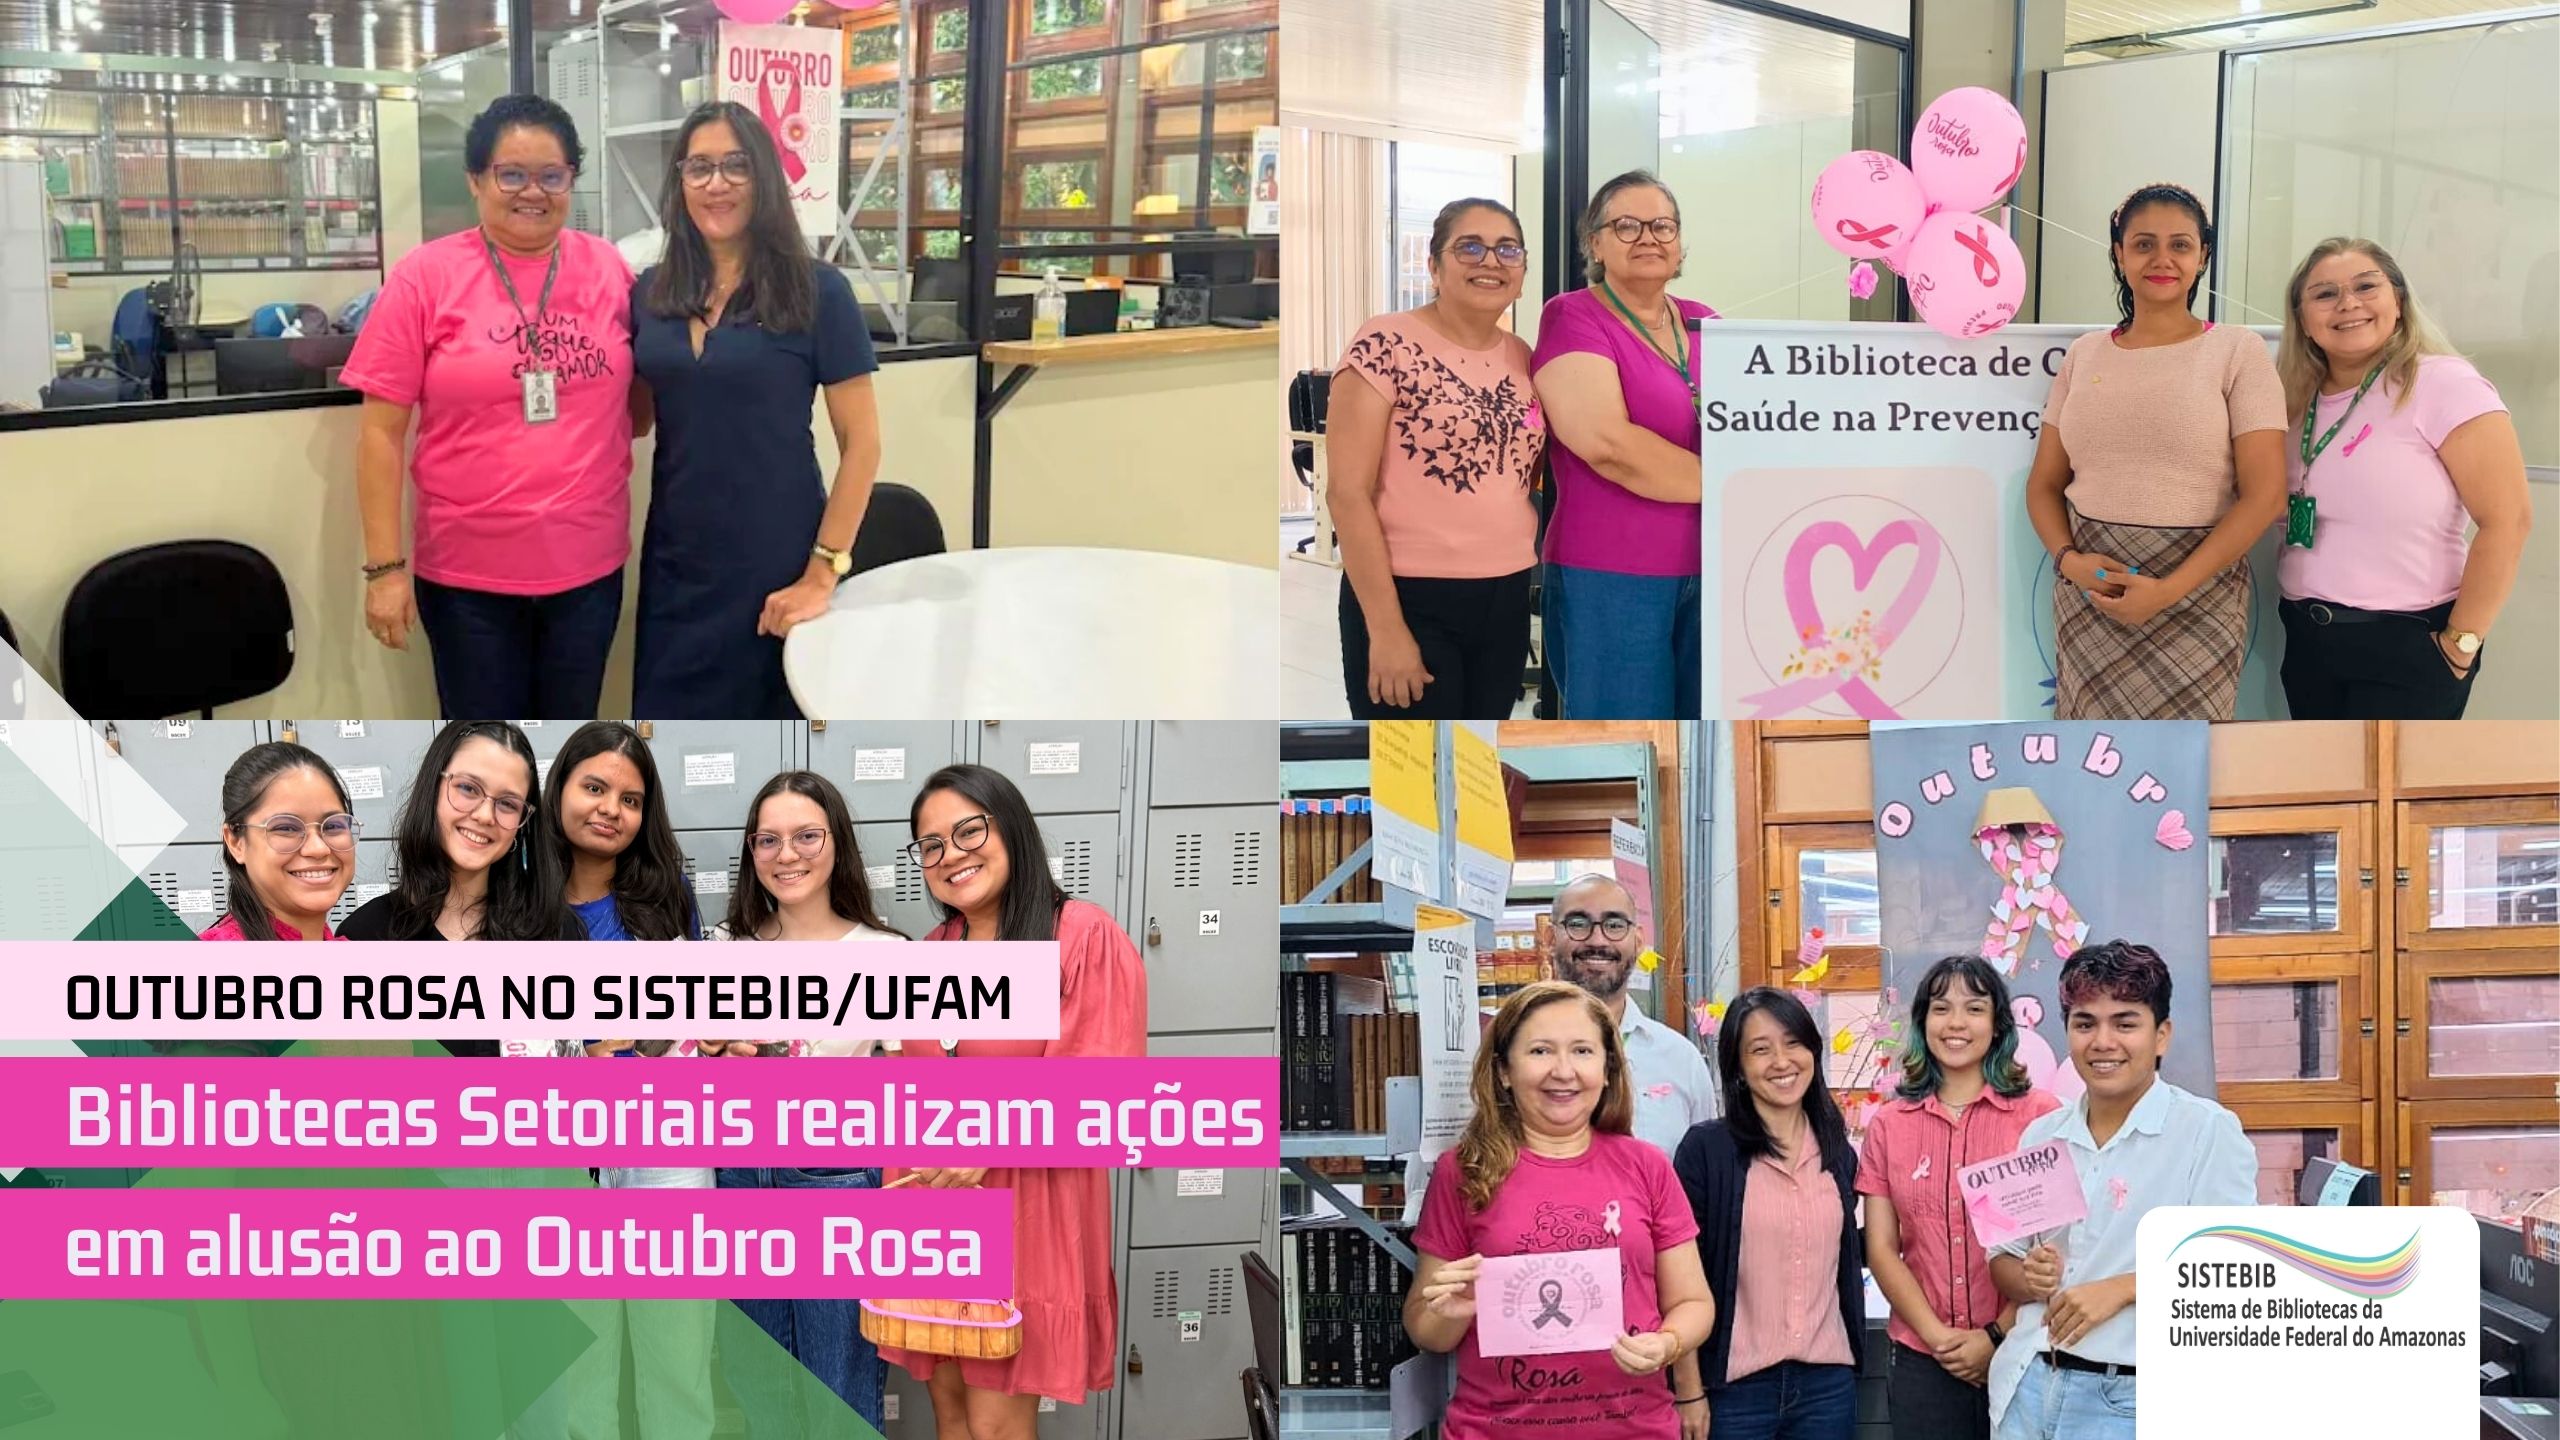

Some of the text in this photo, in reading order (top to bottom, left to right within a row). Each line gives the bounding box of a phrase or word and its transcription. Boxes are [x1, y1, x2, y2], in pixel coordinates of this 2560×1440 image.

[556, 348, 614, 385] AMOR
[1745, 345, 1774, 375] A
[1787, 344, 1977, 376] Biblioteca
[1989, 345, 2031, 377] de
[1707, 400, 2042, 440] Saúde na Prevenç
[1202, 914, 1218, 924] 34
[1967, 1146, 2059, 1189] OUTUBRO
[1184, 1323, 1199, 1333] 36
[1511, 1358, 1584, 1393] Rosa
